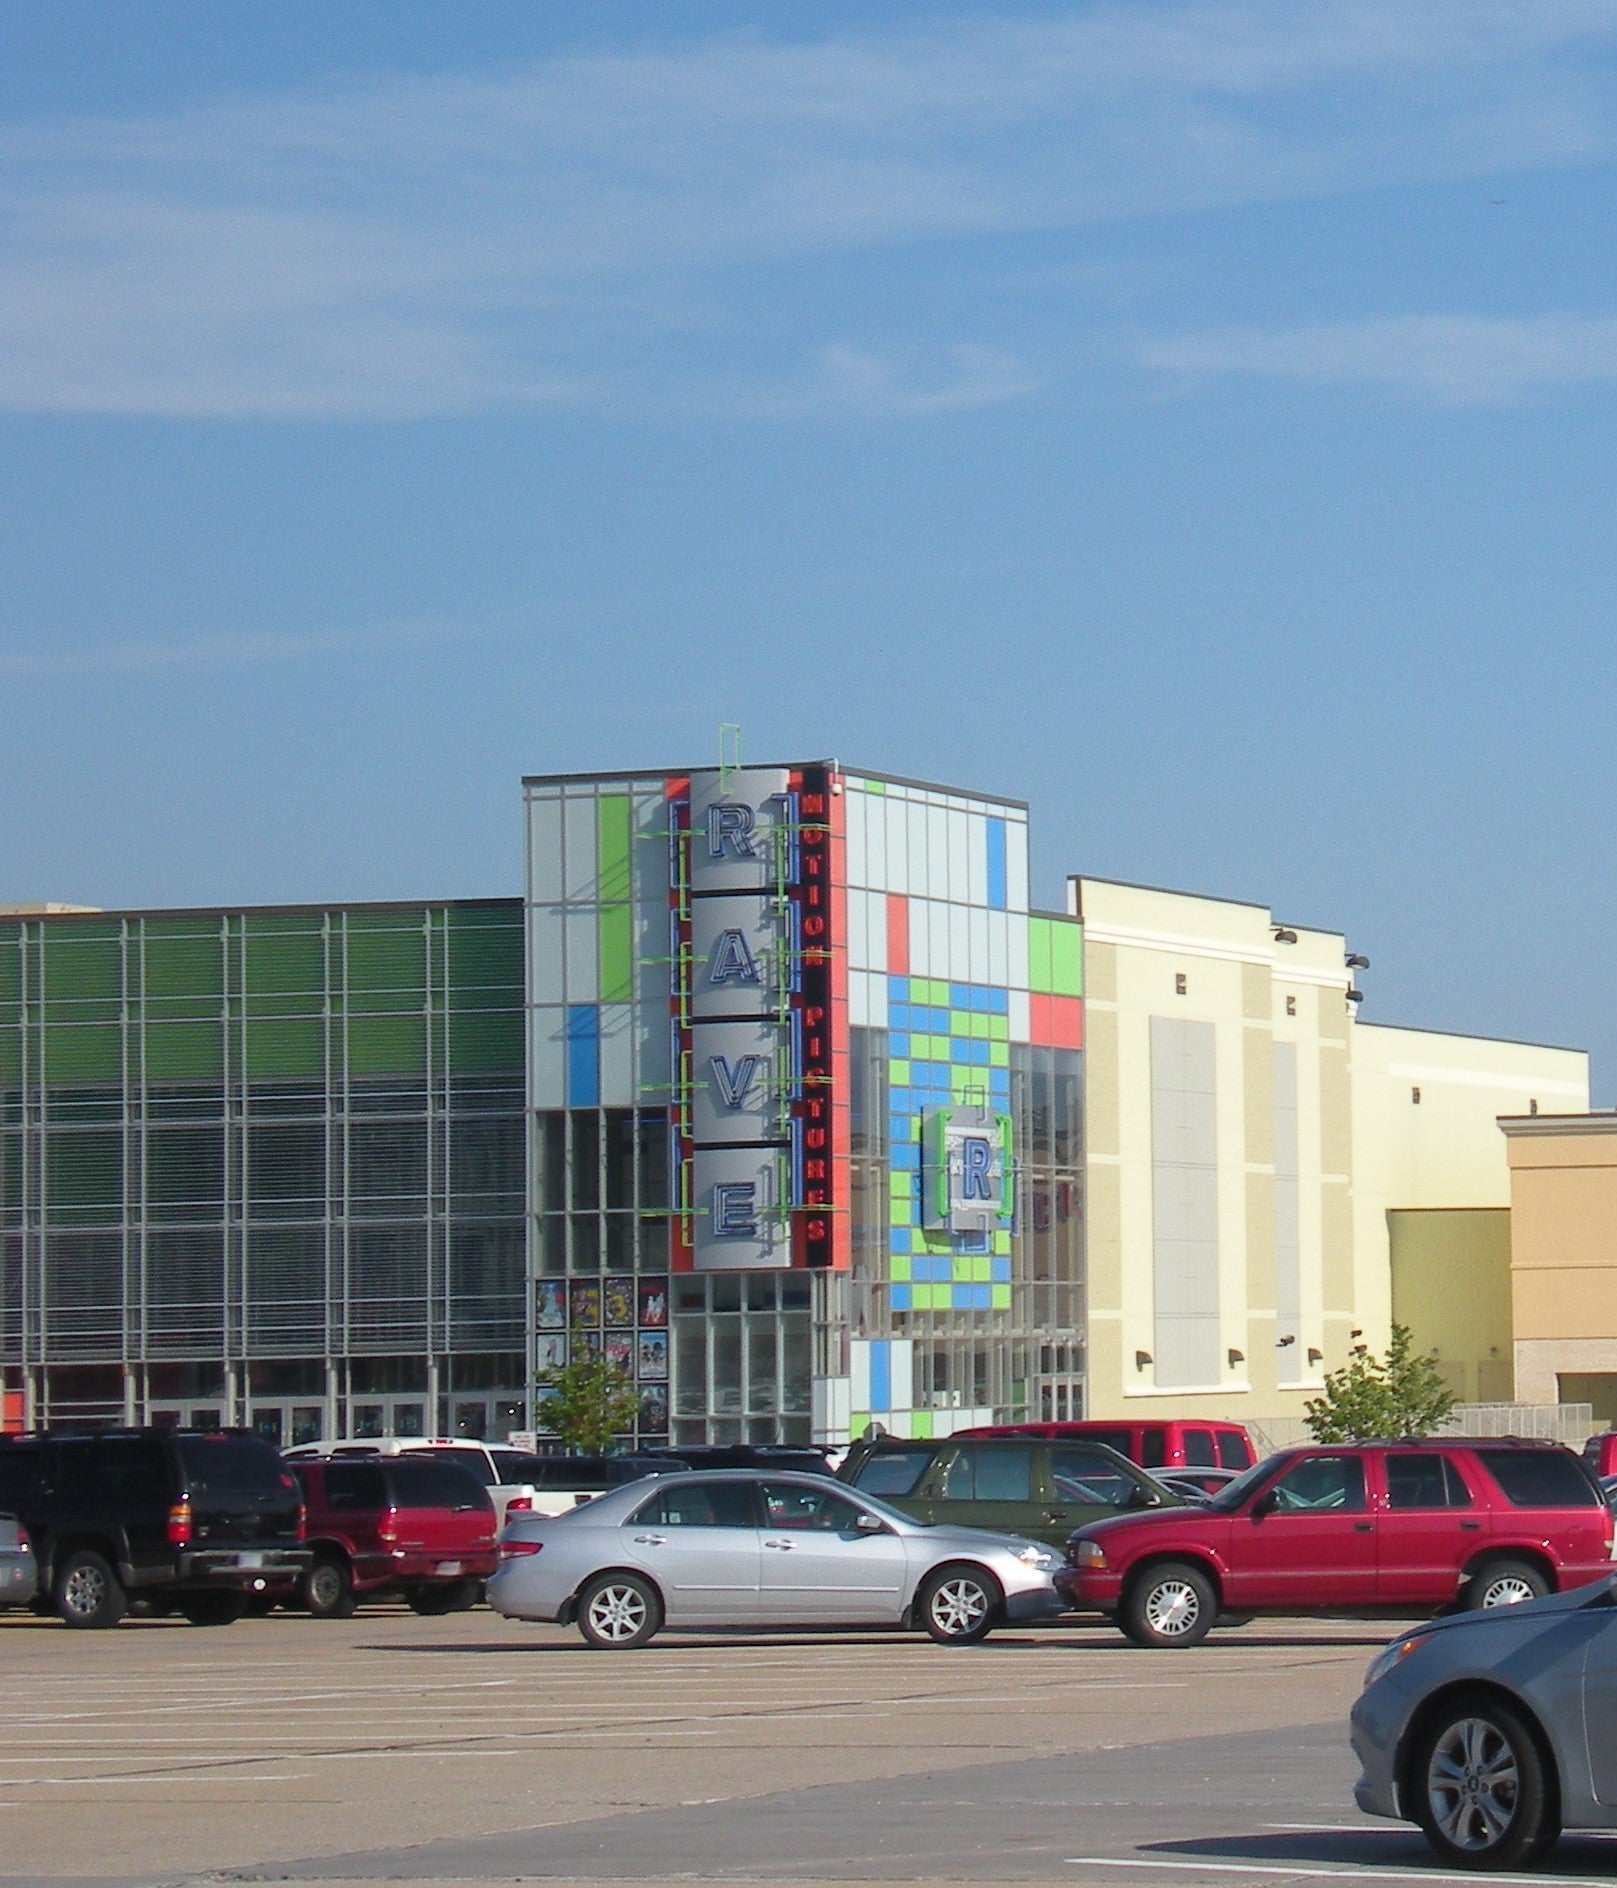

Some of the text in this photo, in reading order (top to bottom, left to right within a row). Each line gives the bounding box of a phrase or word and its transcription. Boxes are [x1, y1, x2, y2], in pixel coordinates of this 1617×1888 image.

[708, 802, 760, 1236] RAVE
[802, 792, 825, 1241] MOTION PICTURES
[963, 1136, 993, 1200] R
